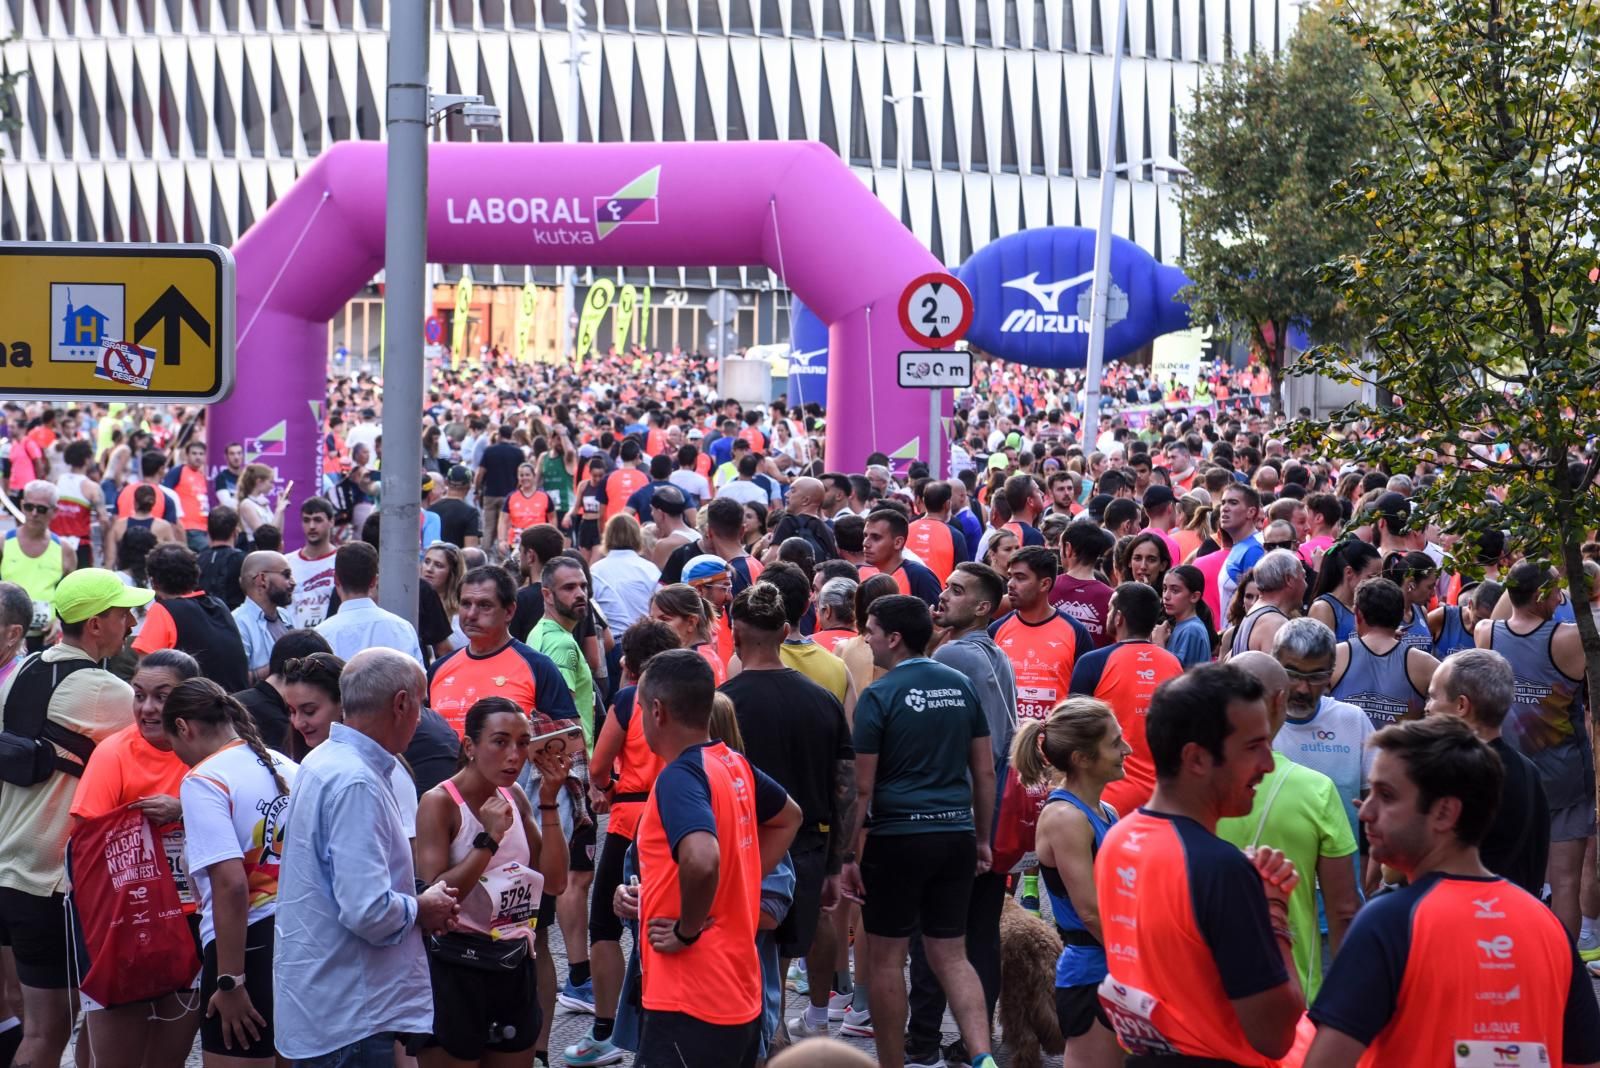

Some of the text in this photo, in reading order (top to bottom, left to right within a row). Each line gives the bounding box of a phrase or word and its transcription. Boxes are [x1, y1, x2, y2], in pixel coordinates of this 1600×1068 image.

[447, 197, 590, 224] LABORAL
[533, 228, 595, 245] kutxa
[921, 296, 951, 323] 2 m
[76, 316, 97, 343] H
[101, 339, 131, 353] ISRAEL
[112, 371, 148, 386] DESEGIN
[949, 366, 964, 376] m
[1017, 703, 1050, 719] 3836
[1300, 742, 1351, 754] autismo
[105, 831, 141, 860] BILBAO
[111, 864, 155, 893] RUNNING FEST
[500, 883, 532, 910] 5794
